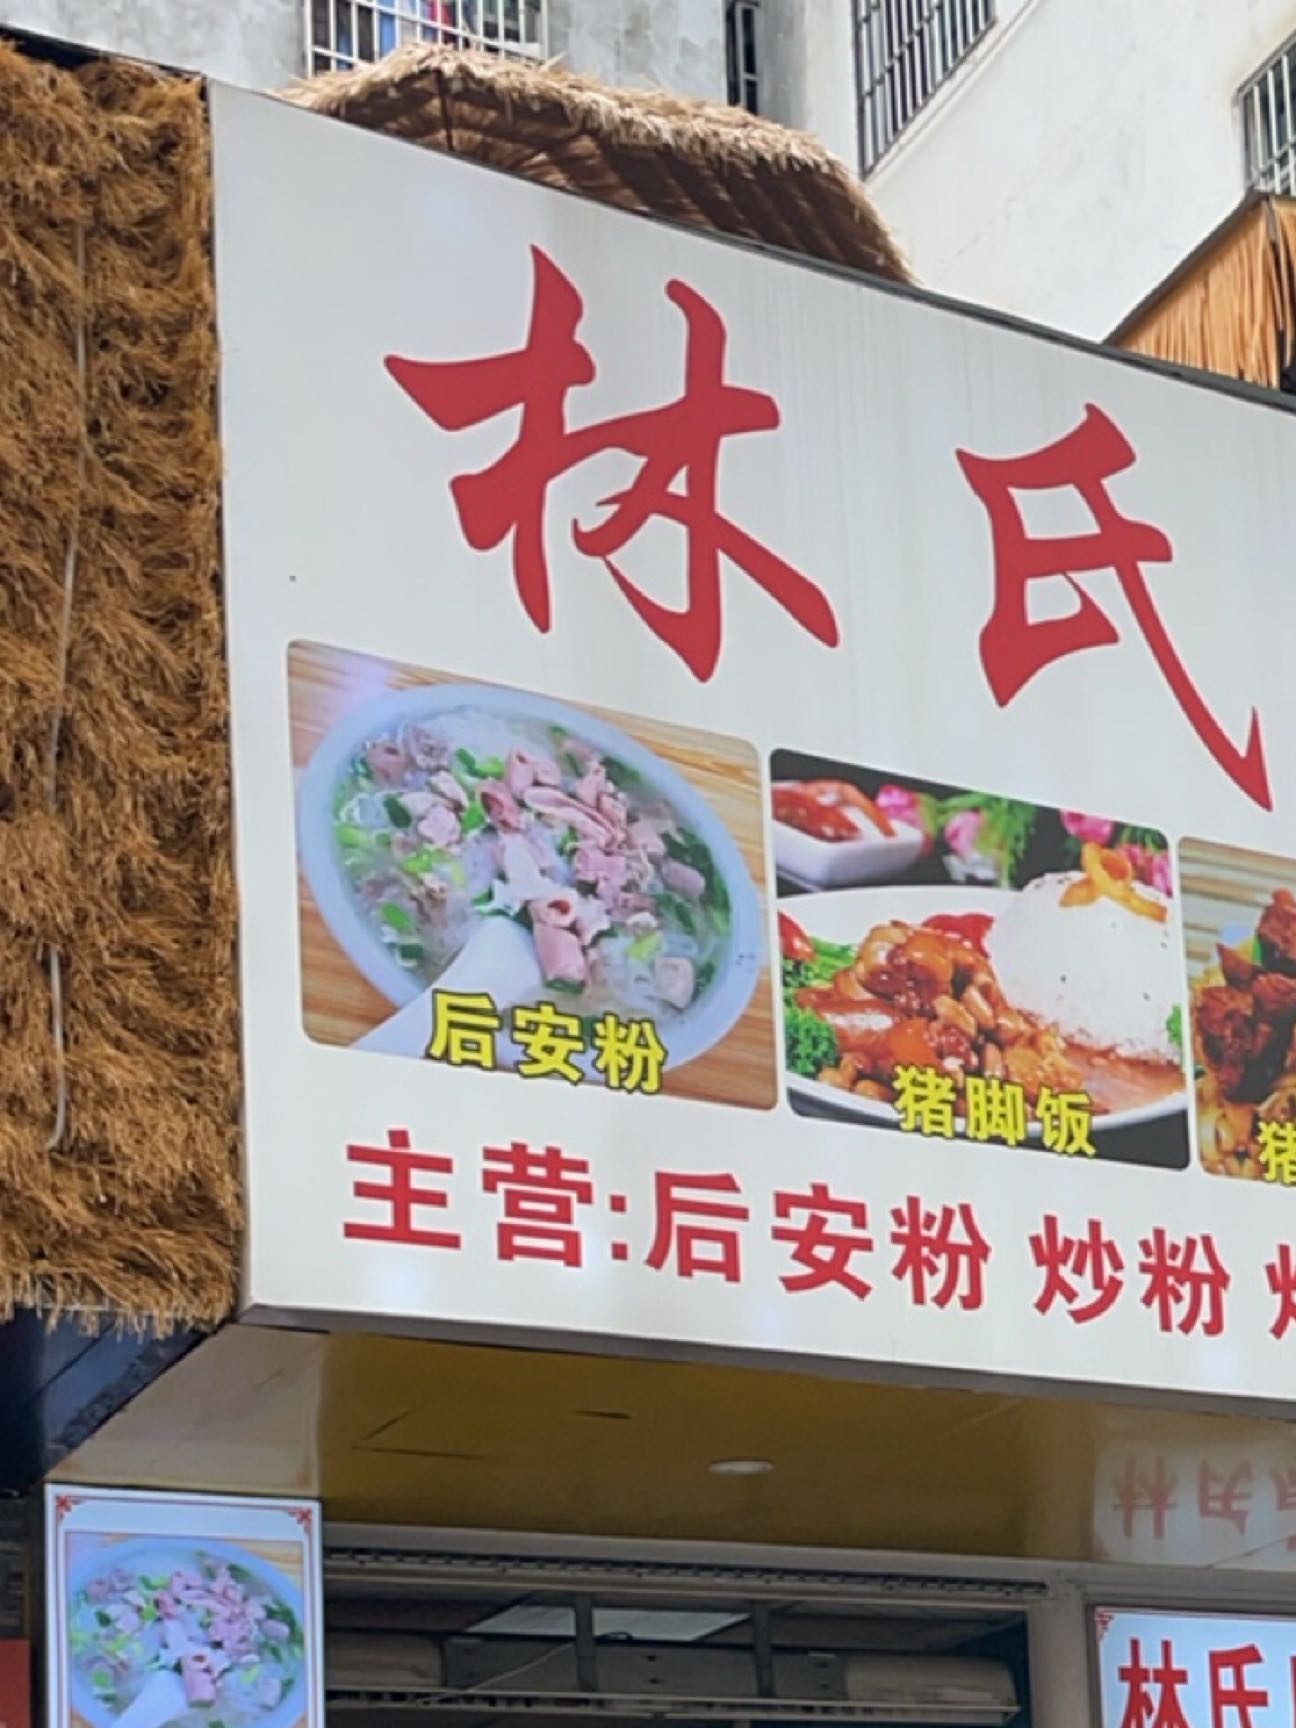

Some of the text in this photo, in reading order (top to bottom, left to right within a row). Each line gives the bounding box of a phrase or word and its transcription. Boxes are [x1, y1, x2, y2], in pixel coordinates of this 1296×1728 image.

[427, 988, 669, 1096] 后安粉
[891, 1064, 1099, 1160] 猪脚饭
[1028, 1213, 1231, 1338] 炒粉
